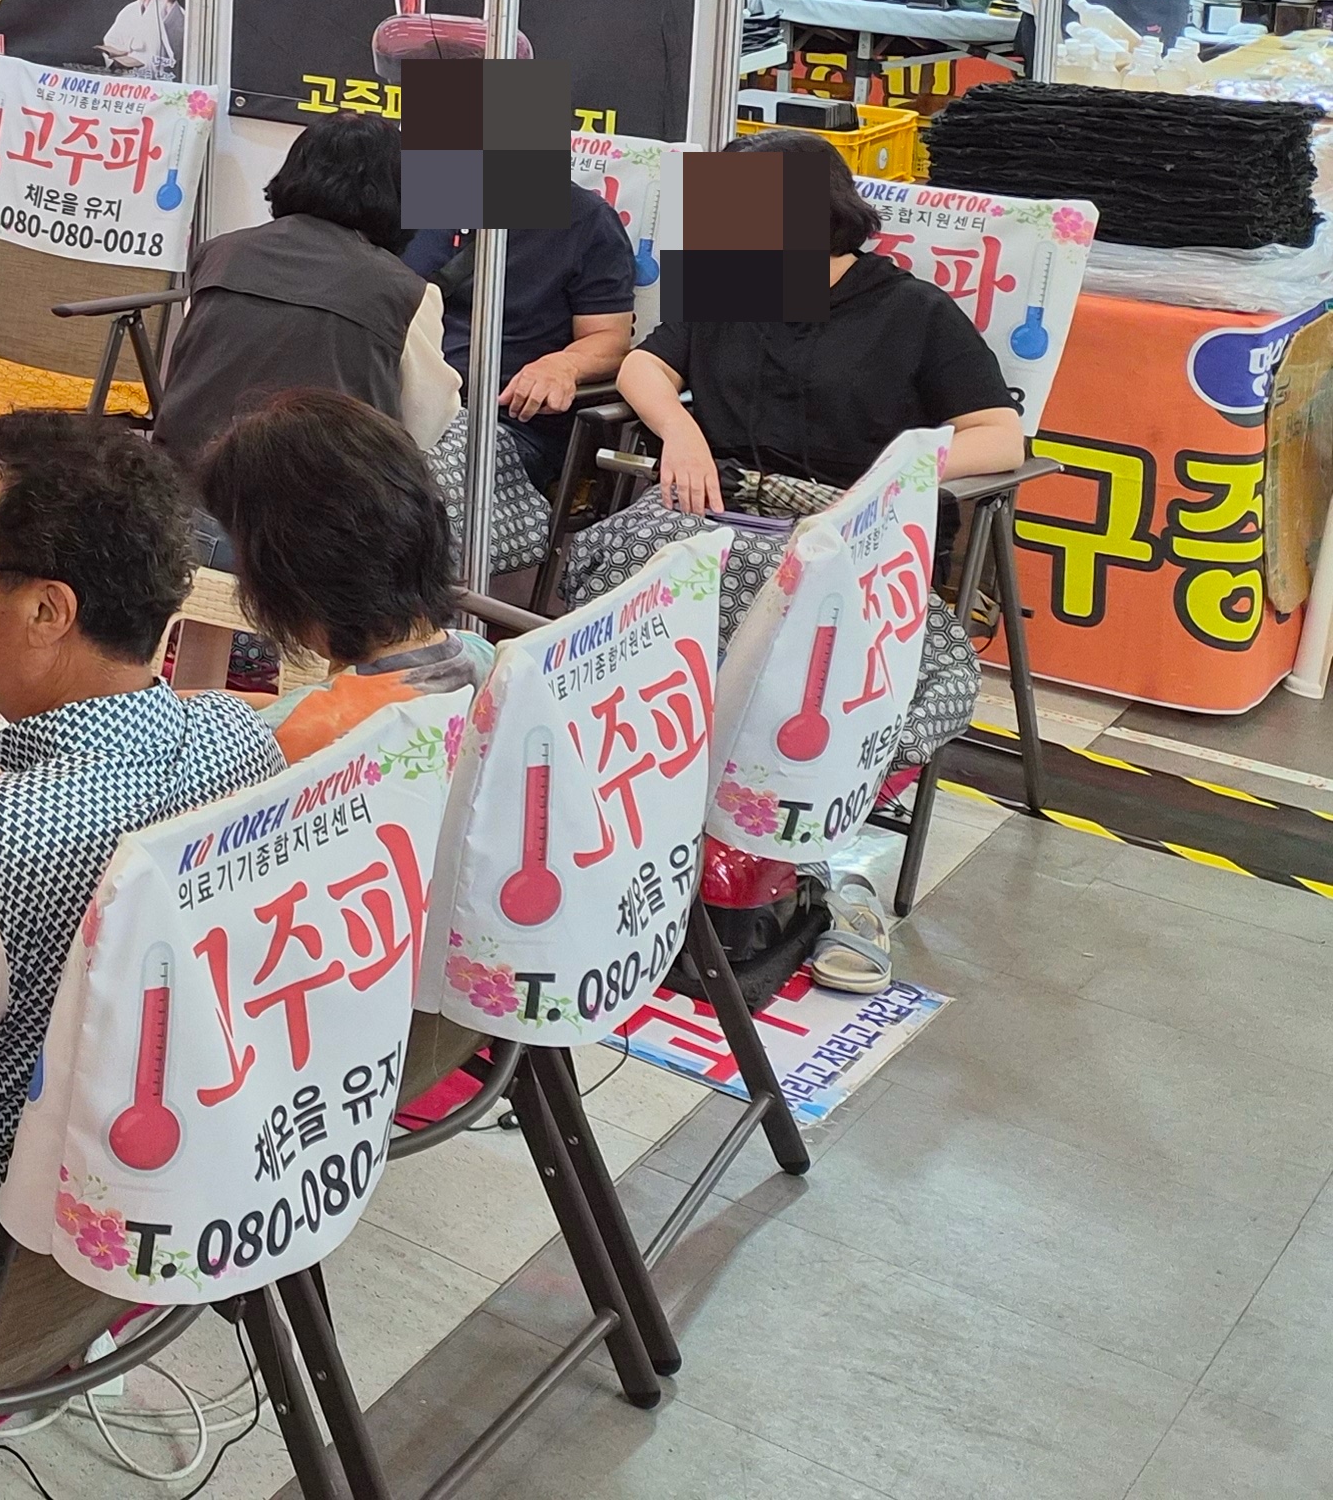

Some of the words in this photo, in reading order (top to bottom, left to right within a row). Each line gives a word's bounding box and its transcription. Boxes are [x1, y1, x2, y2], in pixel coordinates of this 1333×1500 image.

[36, 87, 146, 115] 의료기기종합지원센터
[38, 72, 59, 87] KD
[61, 76, 100, 95] KOREA
[103, 82, 151, 100] DOCTOR
[6, 105, 162, 194] 고주파
[0, 205, 164, 257] 080-080-0018
[24, 183, 79, 216] 체온을
[84, 194, 122, 222] 유지
[916, 190, 991, 213] DOCTOR
[567, 604, 614, 664] KOREA
[619, 579, 659, 633] DOCTOR
[568, 637, 714, 869] 주파
[178, 831, 215, 874] KD
[216, 798, 290, 857] KOREA
[291, 756, 366, 820] DOCTOR
[779, 800, 812, 844] T.
[178, 794, 372, 912] 의료기기종합지원센터
[616, 861, 662, 939] 체온을
[515, 972, 561, 1021] T.
[254, 1085, 327, 1183] 체온을
[342, 1041, 402, 1125] 유지
[124, 1219, 176, 1281] T.
